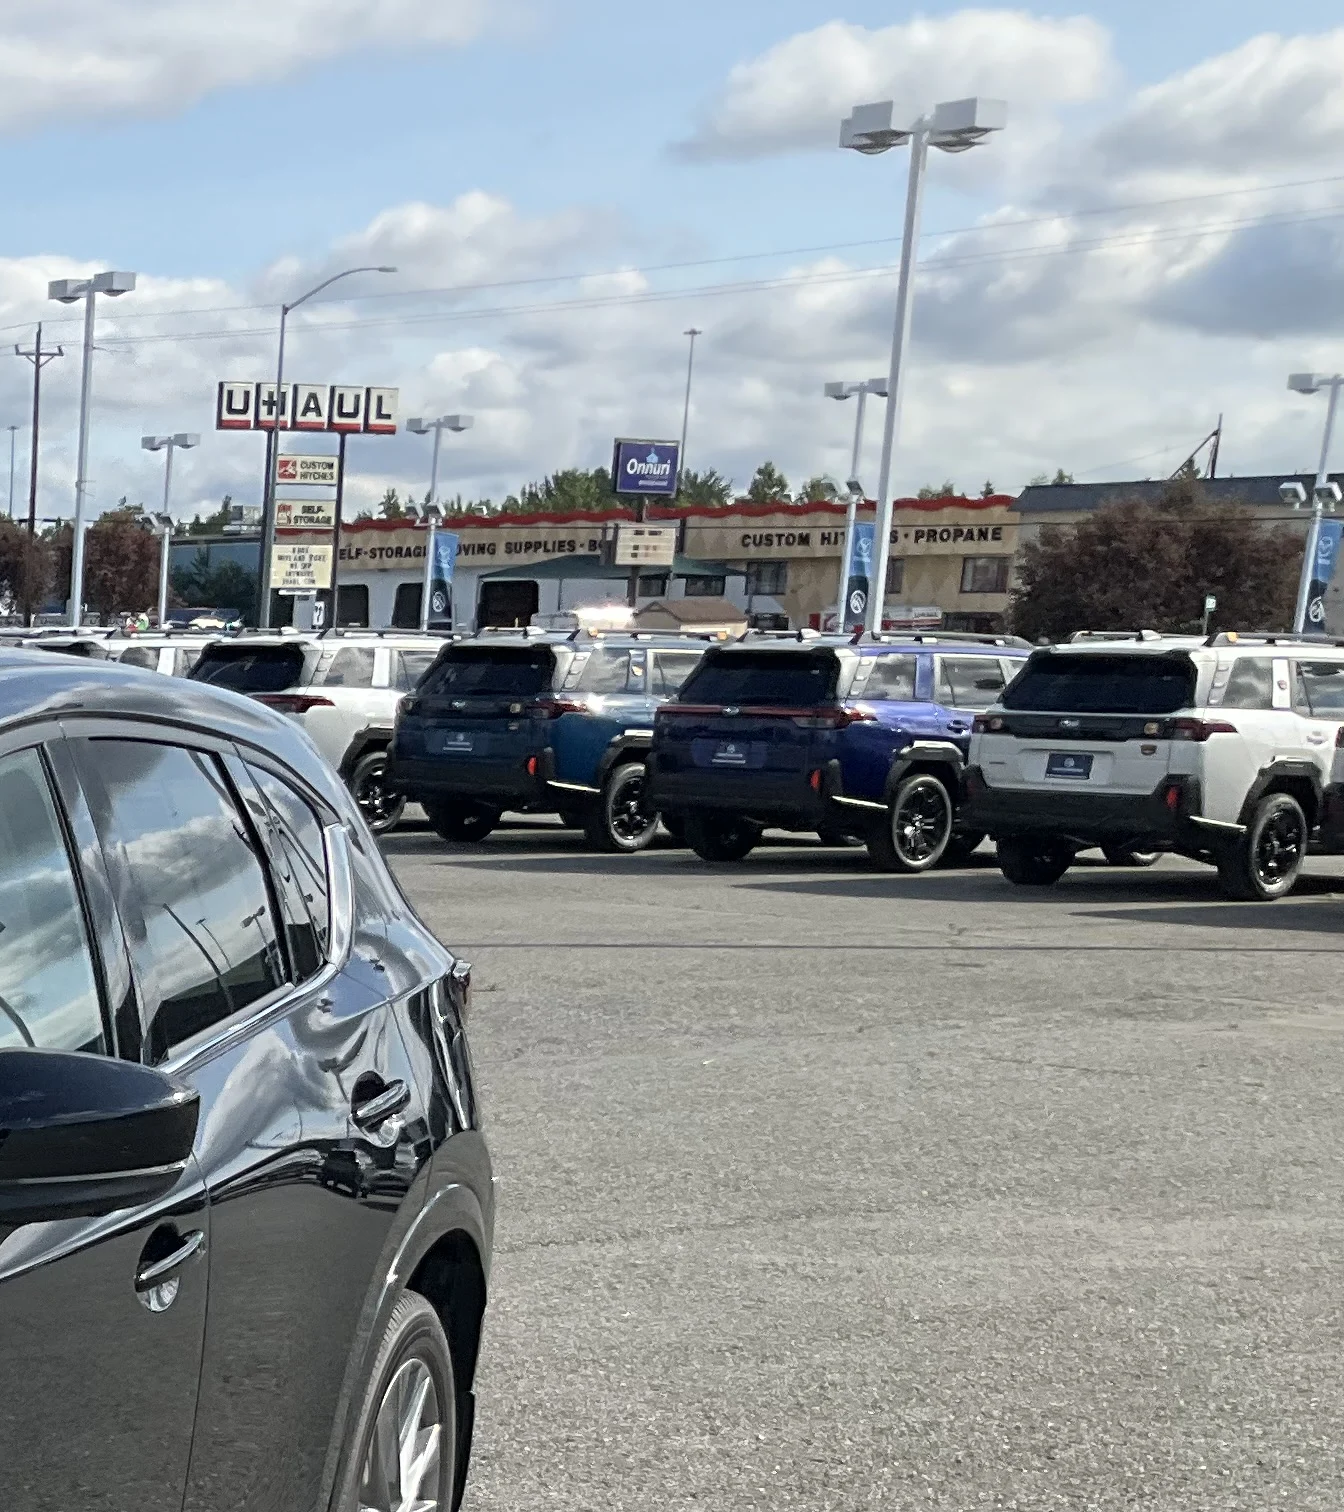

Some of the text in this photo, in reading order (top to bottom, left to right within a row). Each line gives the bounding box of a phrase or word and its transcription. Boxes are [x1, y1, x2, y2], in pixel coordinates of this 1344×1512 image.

[300, 461, 334, 470] CUSTOM
[626, 459, 671, 475] Onnuri
[300, 471, 334, 480] HITCHES
[293, 515, 332, 525] STORAGE
[741, 532, 810, 547] CUSTOM
[914, 526, 1002, 543] PROPANE
[504, 539, 576, 554] SUPPLIES
